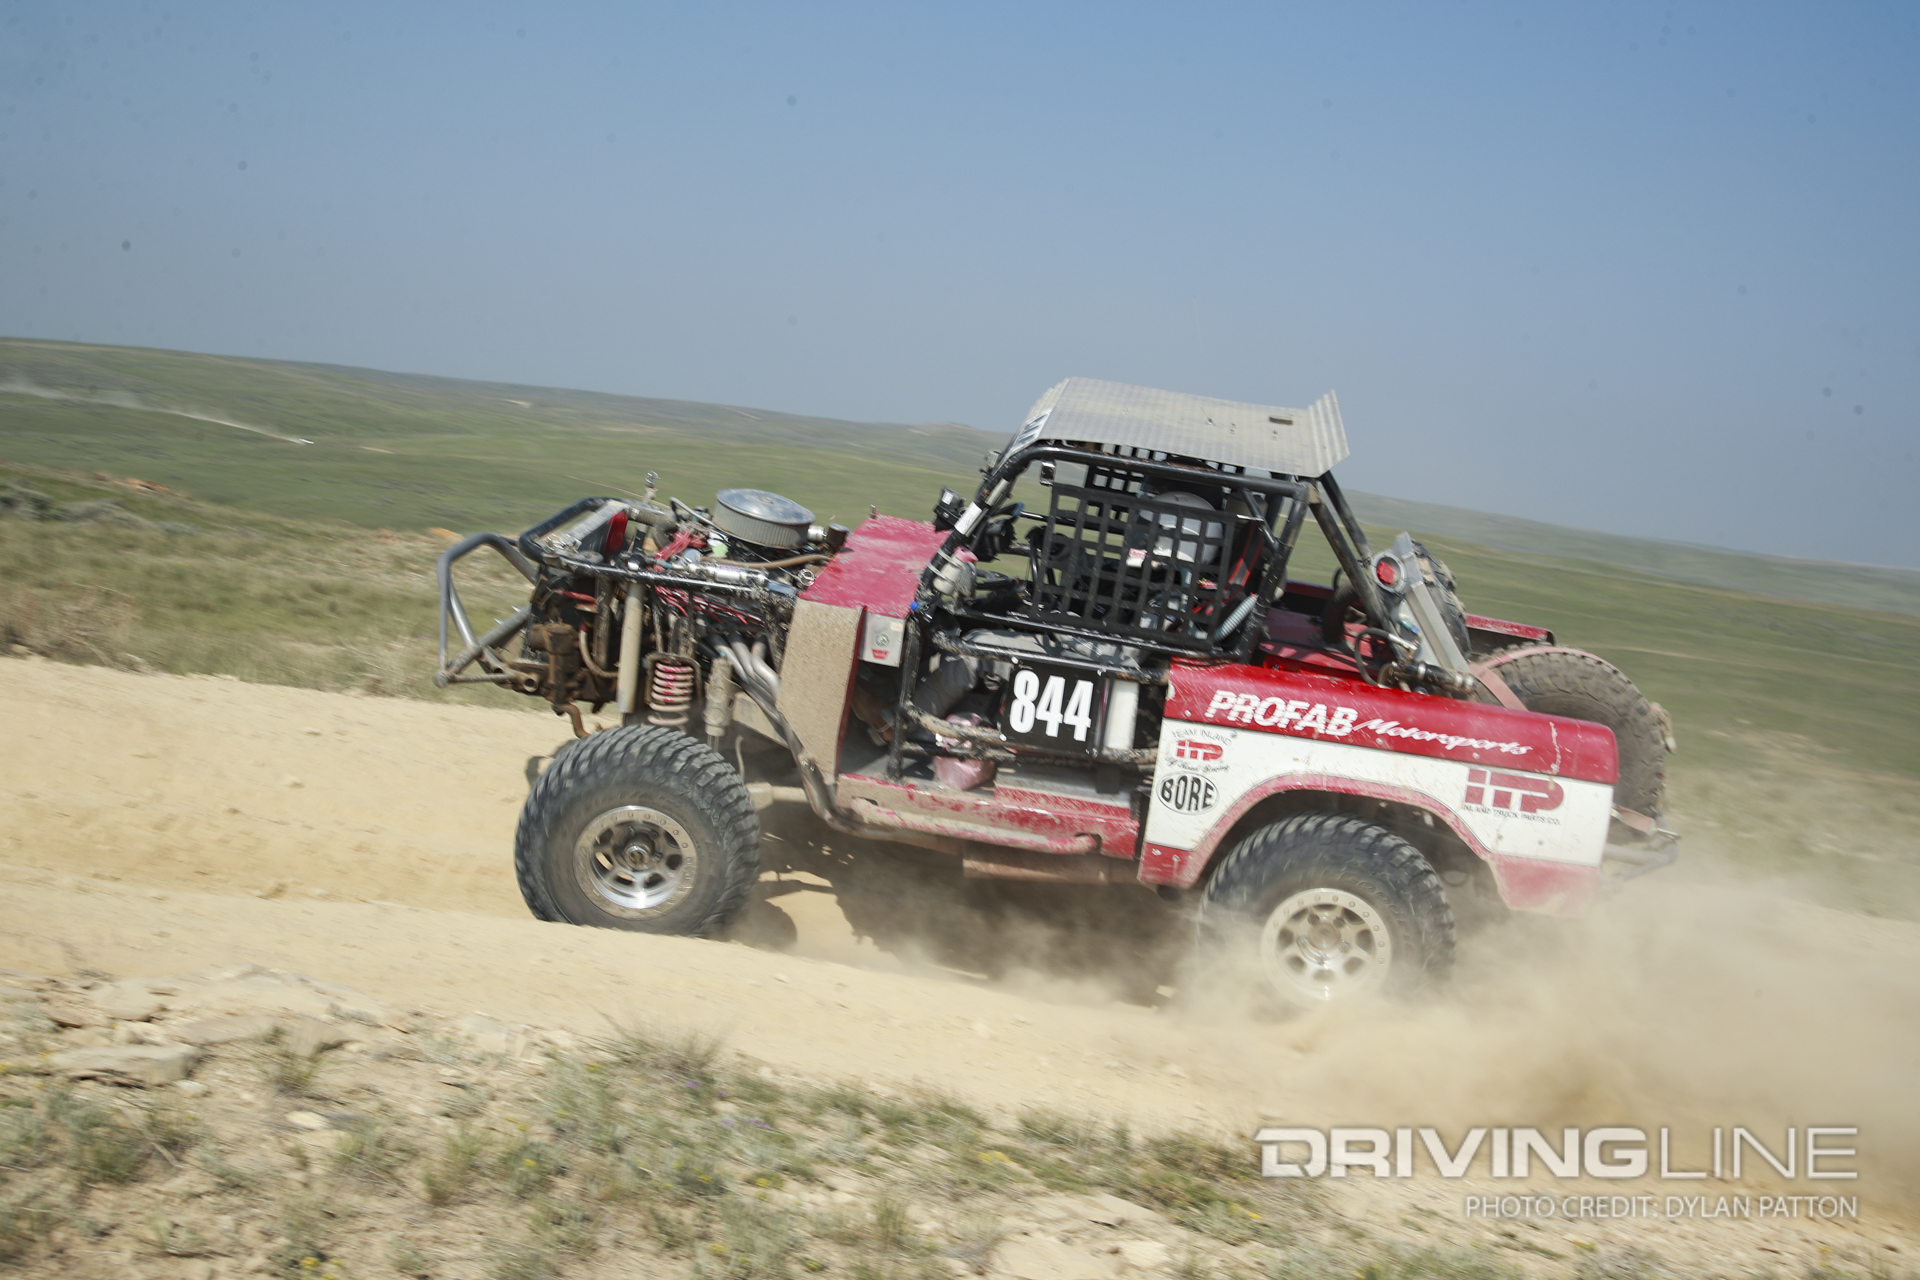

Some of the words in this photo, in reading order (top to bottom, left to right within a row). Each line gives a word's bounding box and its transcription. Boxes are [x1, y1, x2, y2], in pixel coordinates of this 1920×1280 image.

[1010, 669, 1094, 742] 844
[1204, 689, 1359, 737] PROFAB
[1353, 717, 1533, 756] Motorsports
[1161, 775, 1214, 811] BORE
